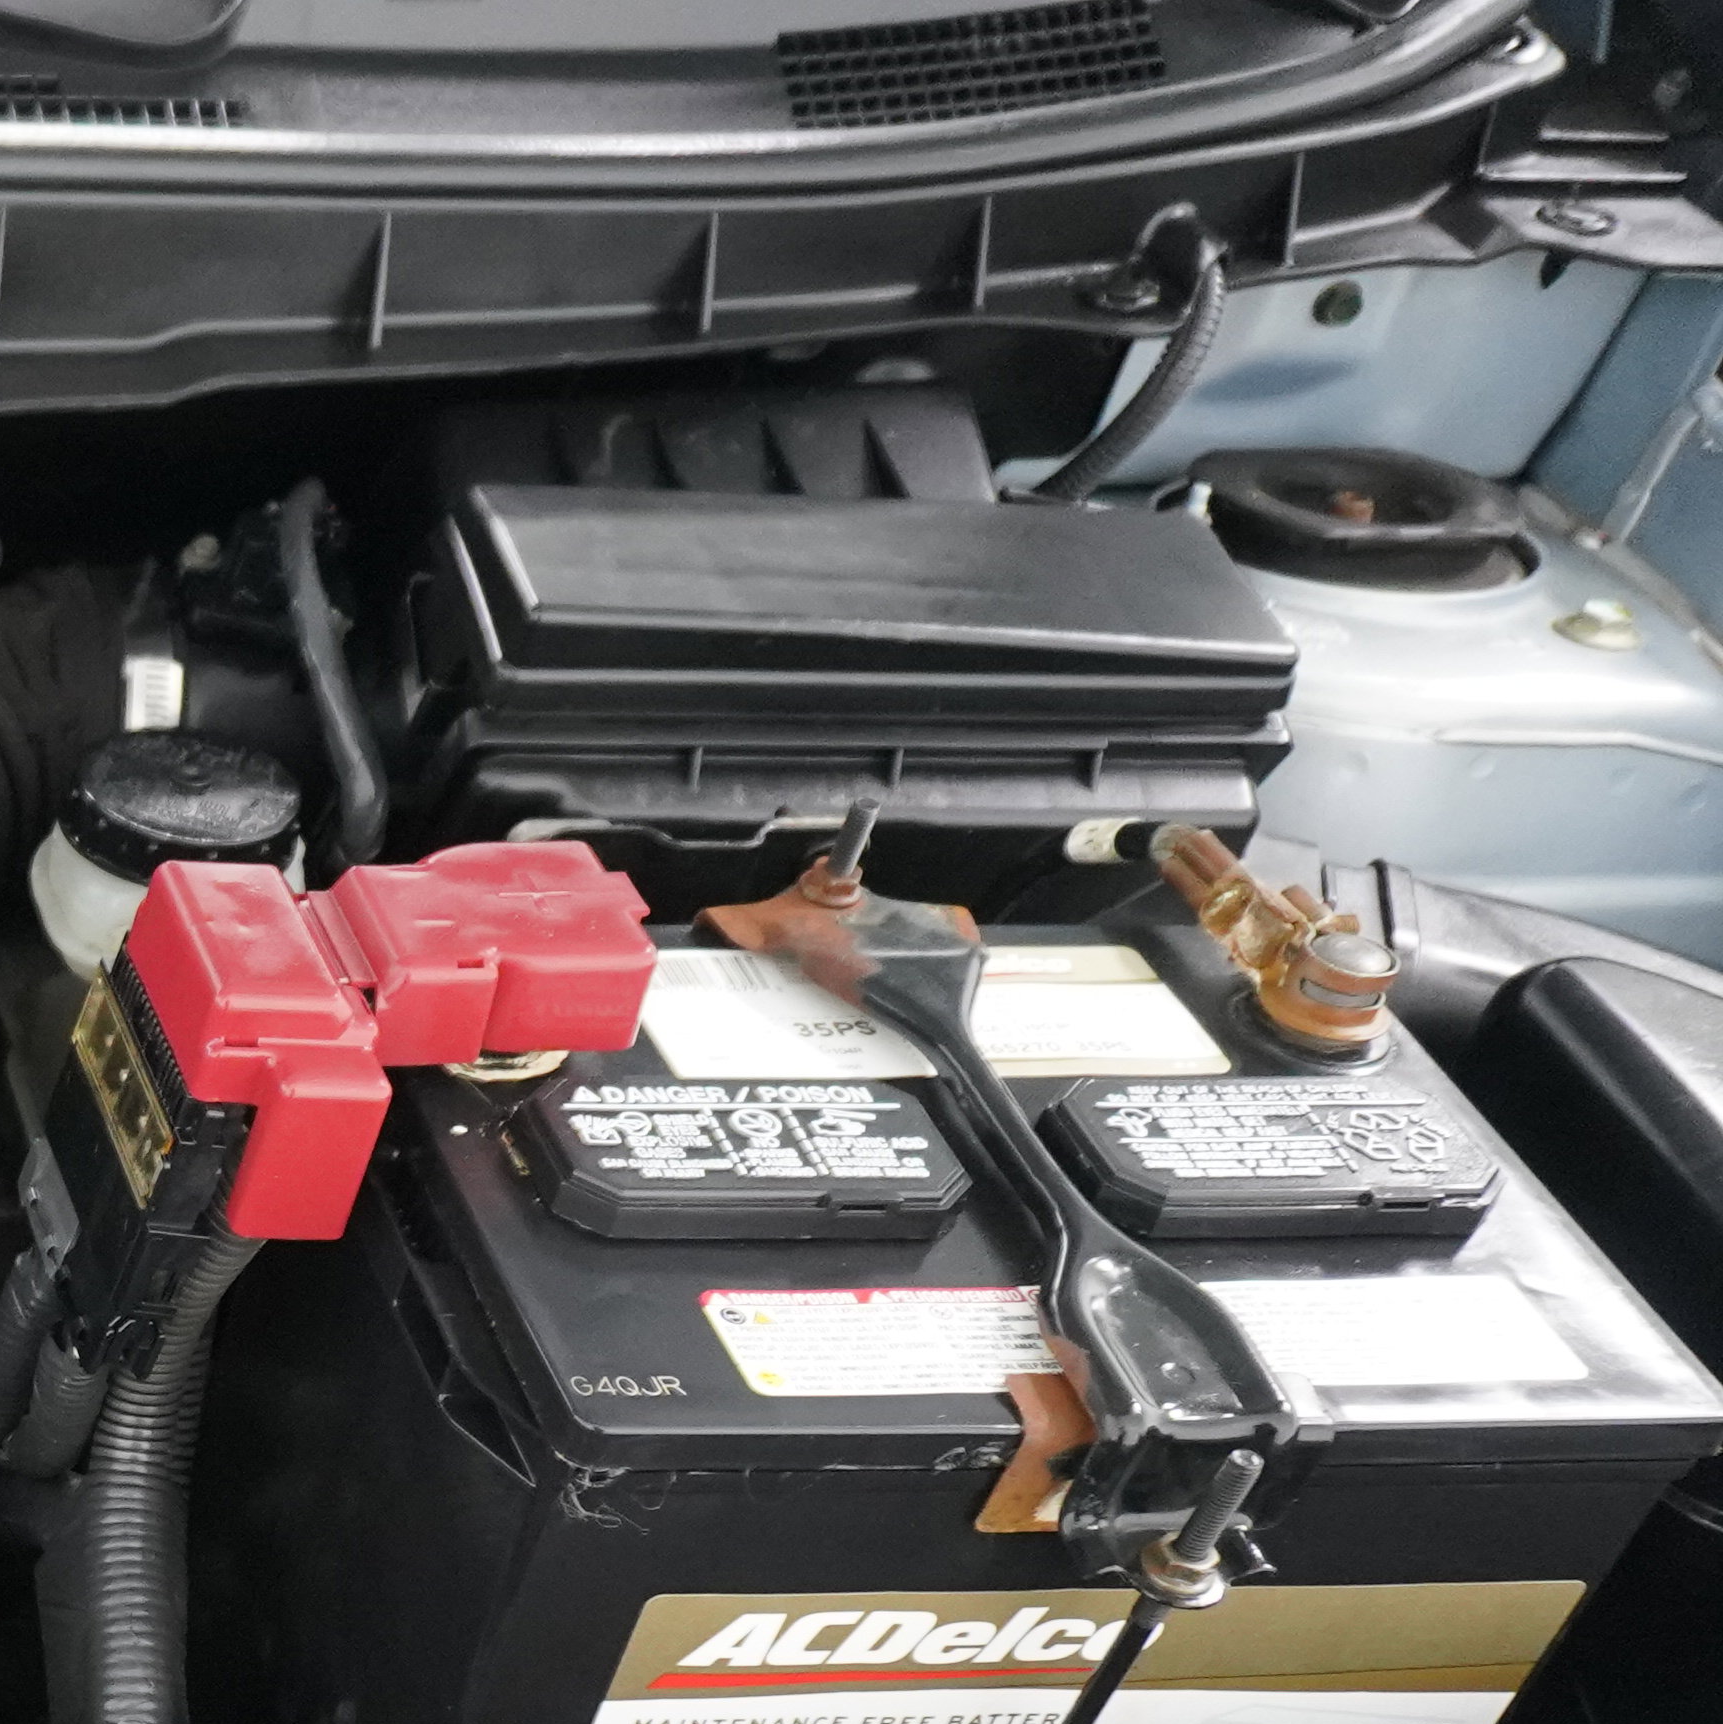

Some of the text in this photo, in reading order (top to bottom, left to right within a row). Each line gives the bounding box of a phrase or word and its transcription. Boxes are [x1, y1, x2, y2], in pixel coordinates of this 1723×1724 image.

[601, 1086, 730, 1103] DANGER
[755, 1086, 875, 1103] POISON
[570, 1366, 687, 1396] G4QJR
